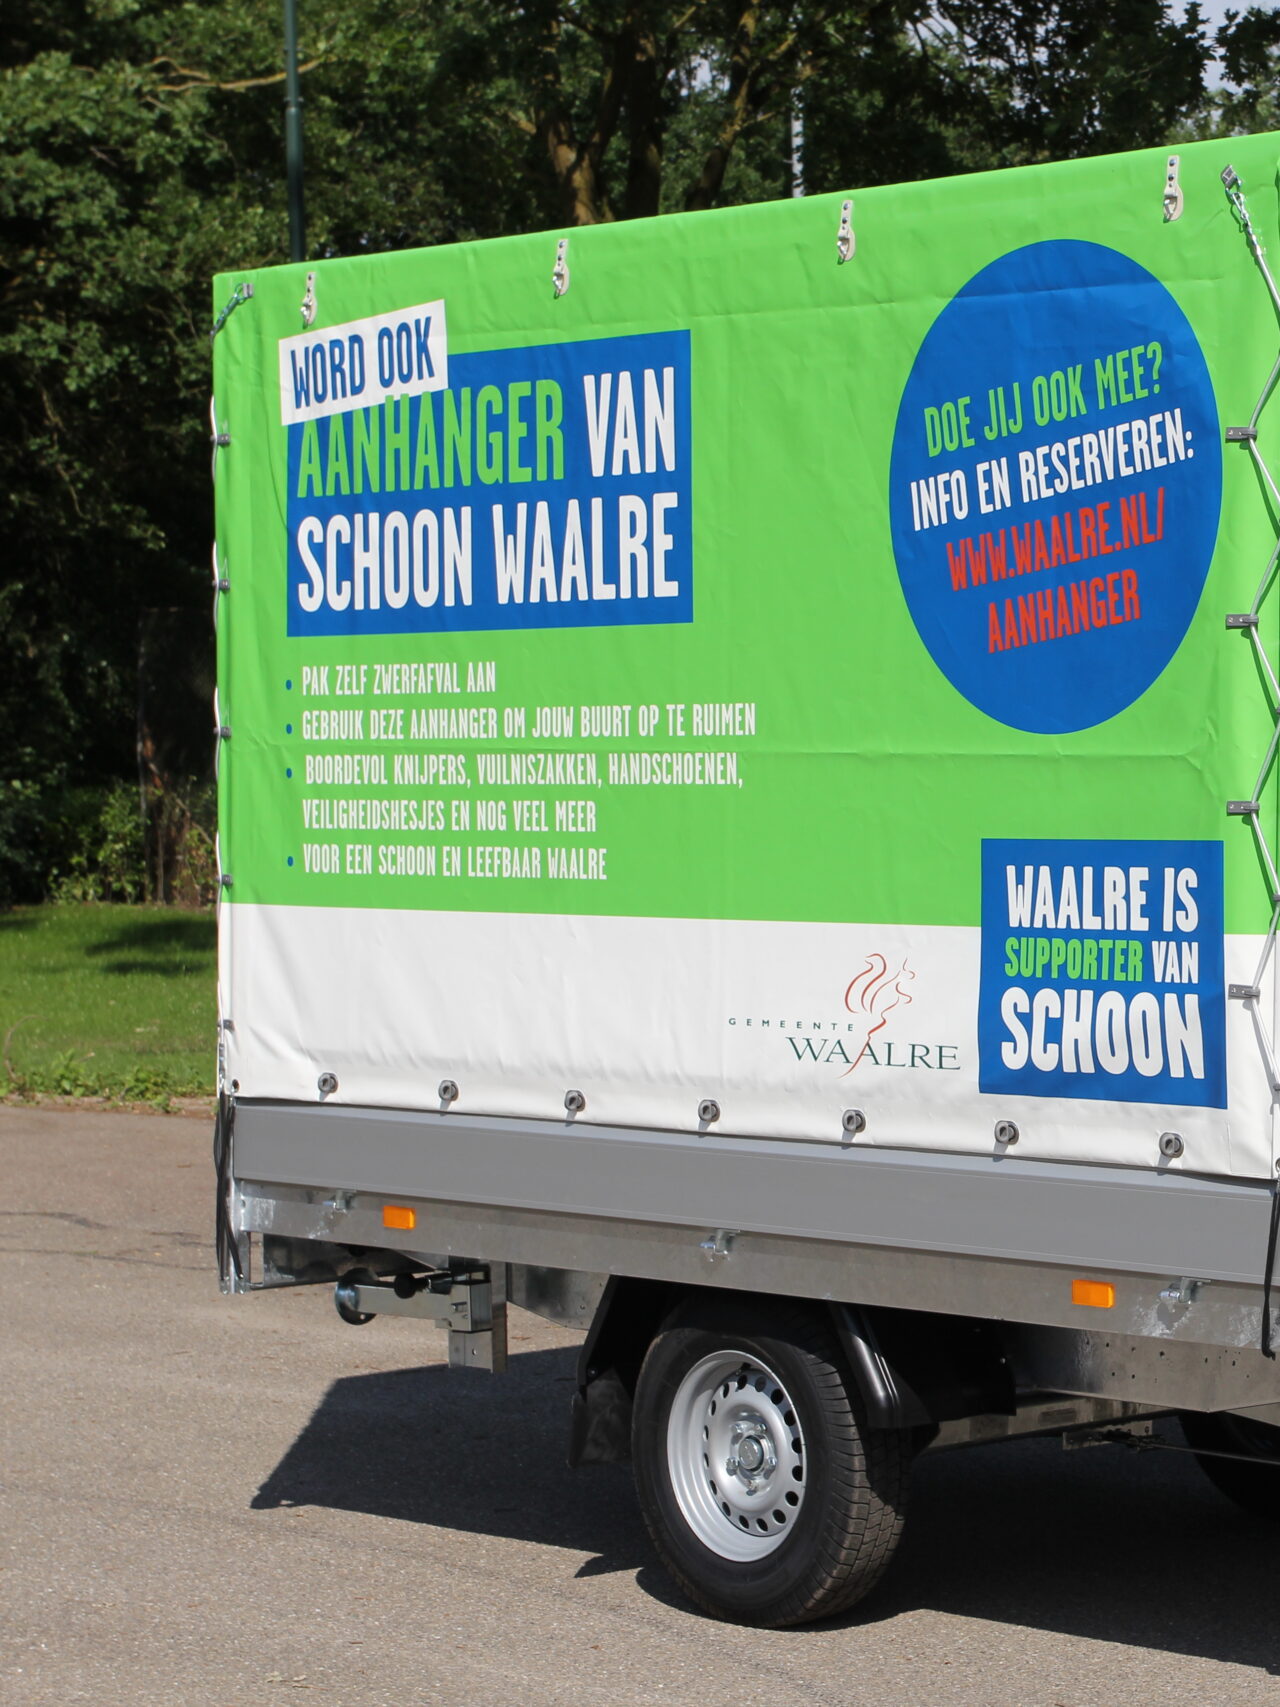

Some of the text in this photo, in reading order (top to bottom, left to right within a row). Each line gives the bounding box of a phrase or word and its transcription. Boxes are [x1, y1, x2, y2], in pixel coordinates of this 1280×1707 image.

[290, 316, 435, 409] WORD OOK
[297, 366, 676, 498] AANHANGER VAN
[924, 341, 1163, 457] DOE JIJ OOK MEE?
[910, 408, 1194, 531] INFO EN RESERVEREN:
[297, 491, 679, 612] SCHOON WAALRE
[946, 486, 1165, 591] WWW.WAALRE.NL/
[988, 568, 1141, 653] AANHANGER
[302, 661, 496, 696] PAK ZELF ZWERFAFVAL AAN
[302, 702, 756, 740] GEBRUIK DEZE AANHANGER OM JOUW BUURT OP TE RUIMEN
[305, 752, 743, 788] BOORDEVOL KNIJPERS, VUILNISZAKKEN, HANDSCHOENEN,
[302, 799, 596, 832] VEILIGHEIDSHESJES EN NOG VEEL MEER
[303, 843, 607, 880] VOOR EEN SCHOON EN LEEFBAAR WAALRE
[1006, 864, 1199, 933] WAALRE IS
[1004, 936, 1199, 984] SUPPORTER VAN
[728, 1016, 855, 1033] GEMEENTE
[785, 1036, 961, 1072] WAALRE
[1000, 986, 1205, 1080] SCHOON
